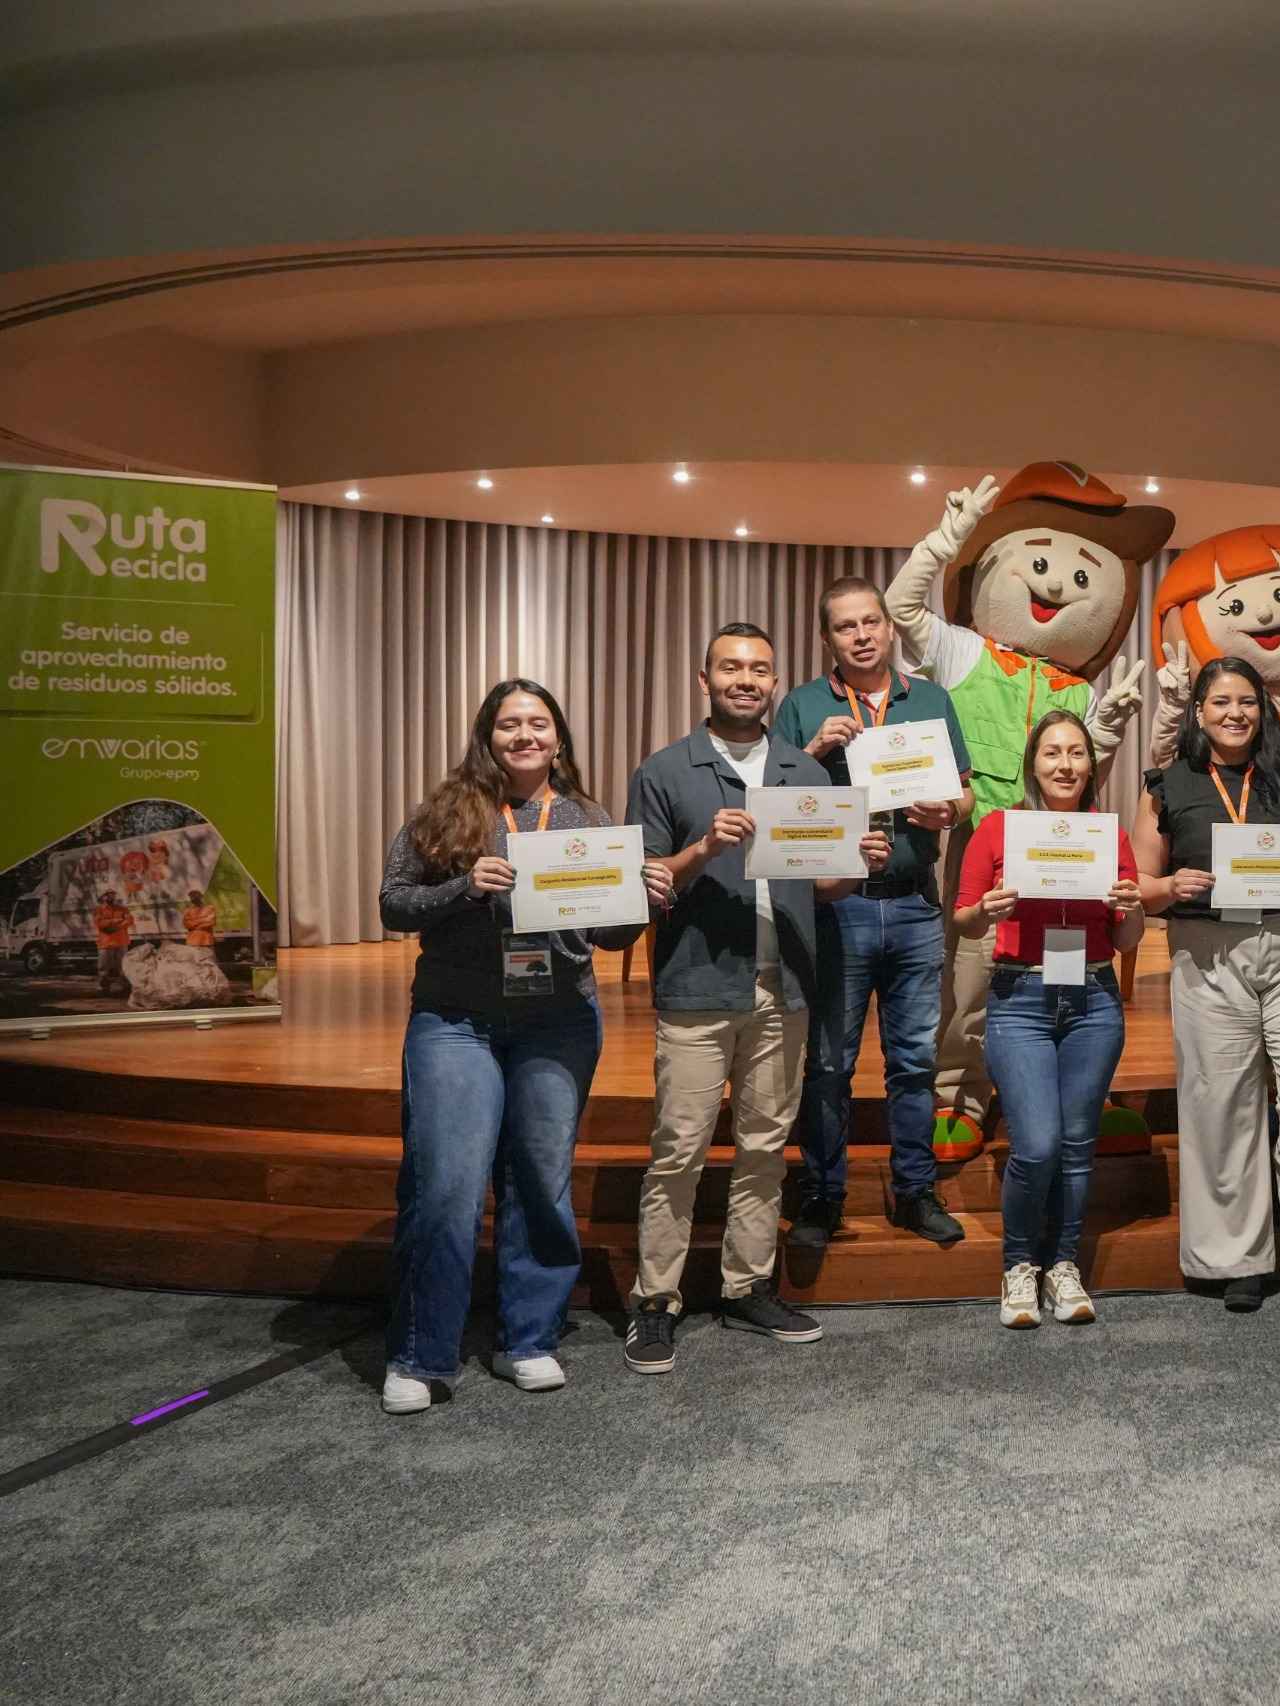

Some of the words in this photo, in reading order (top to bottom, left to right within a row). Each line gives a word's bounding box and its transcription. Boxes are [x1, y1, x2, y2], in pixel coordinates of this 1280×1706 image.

[61, 621, 152, 643] Servicio
[160, 626, 190, 645] de
[20, 648, 227, 671] aprovechamiento
[8, 670, 40, 690] de
[48, 672, 147, 693] residuos
[154, 675, 238, 697] sólidos.
[41, 735, 200, 760] emvarias
